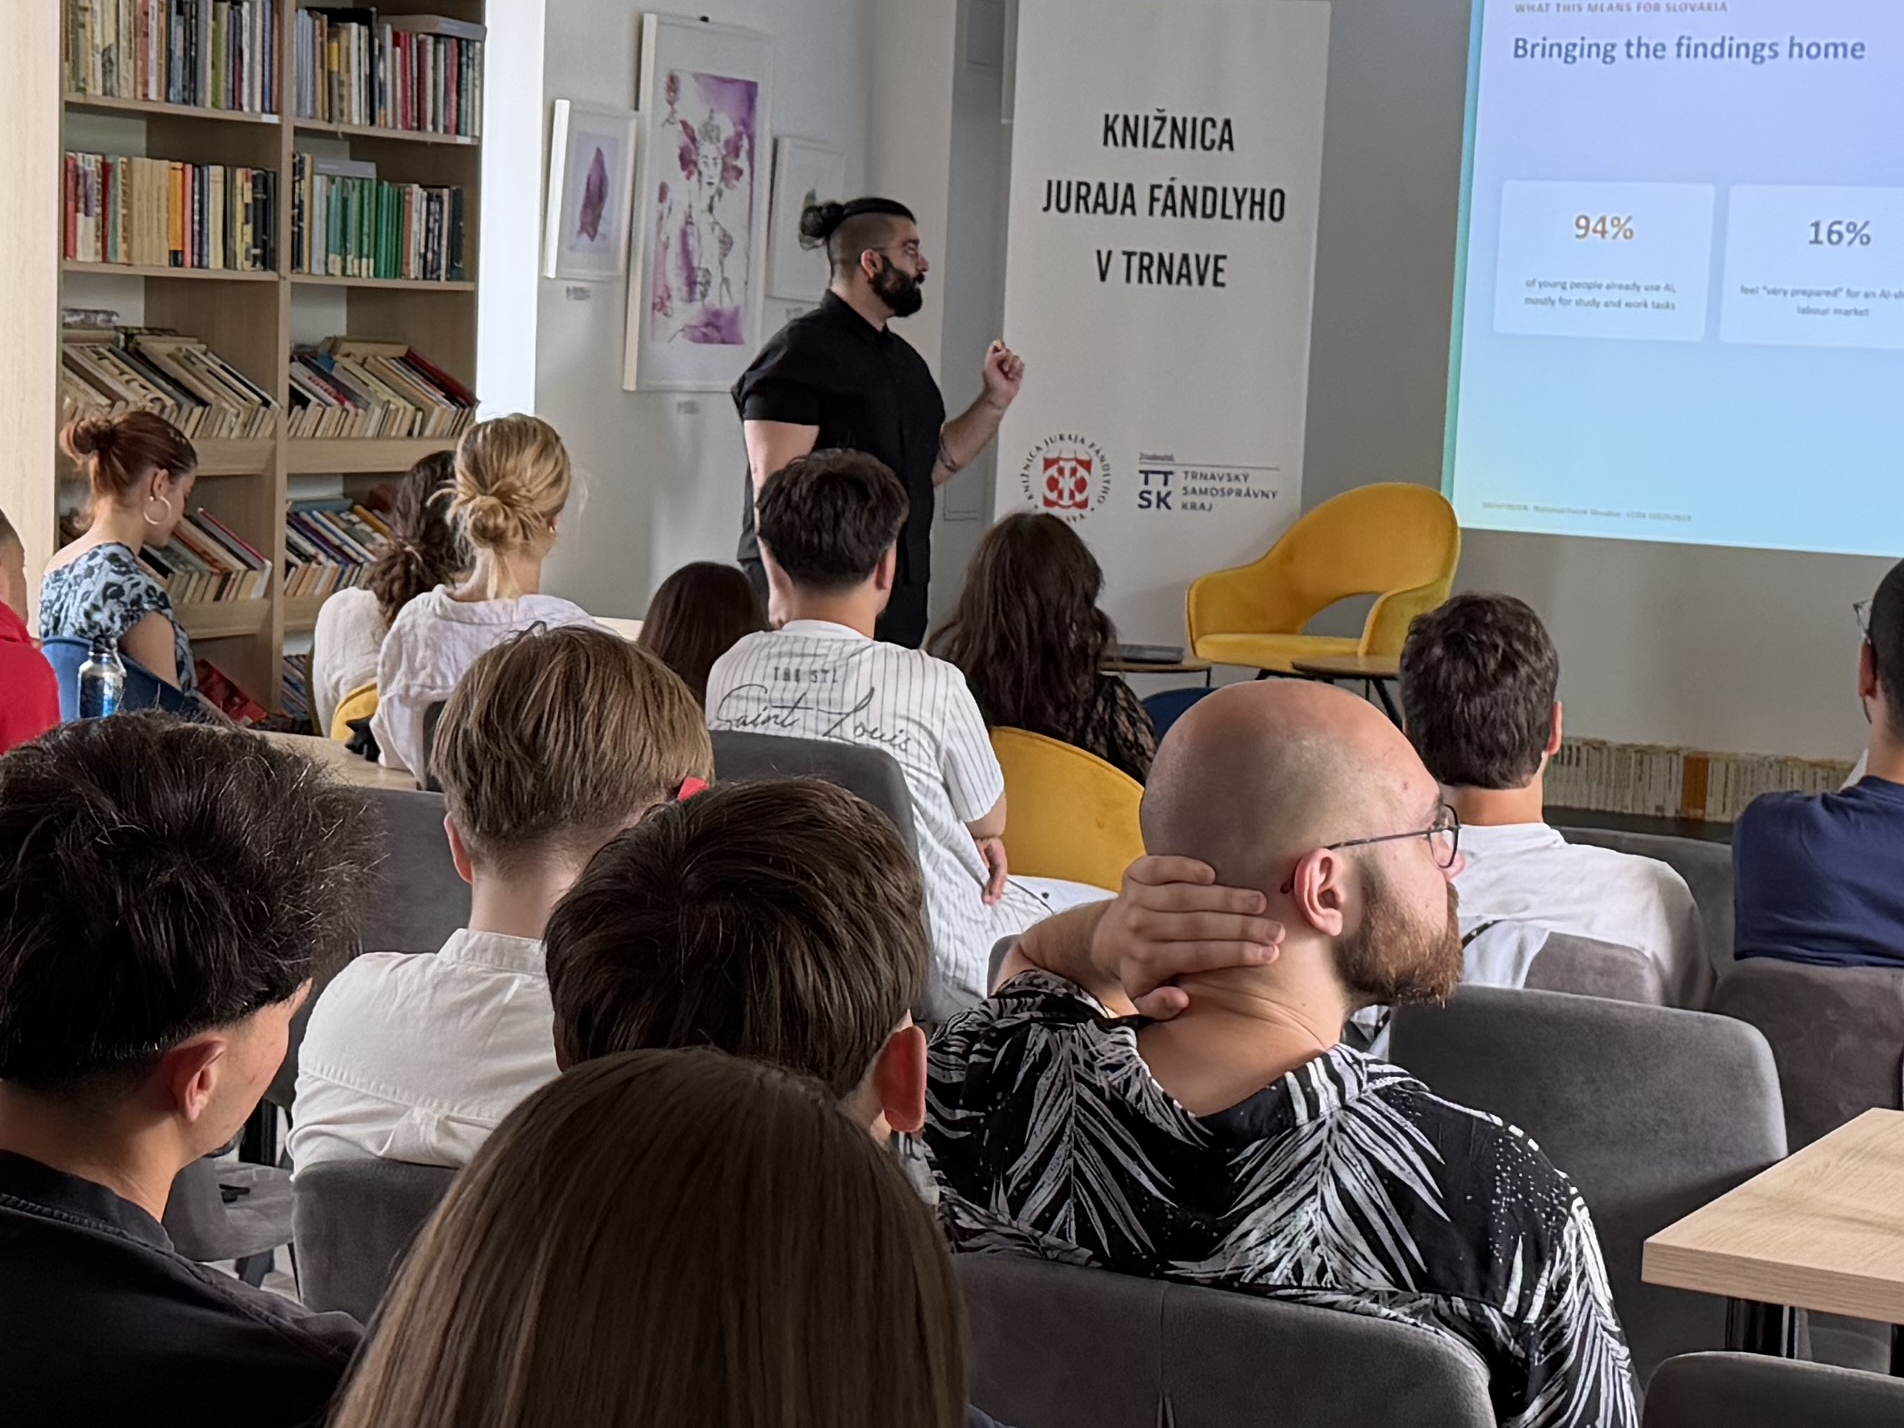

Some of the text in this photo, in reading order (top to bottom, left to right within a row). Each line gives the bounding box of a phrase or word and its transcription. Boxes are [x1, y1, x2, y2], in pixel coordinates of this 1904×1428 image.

[1515, 1, 1728, 13] WHAT THIS MEANS FOR SLOVAKIA
[1513, 35, 1866, 65] Bringing the findings home
[1102, 107, 1234, 152] KNIŽNICA
[1042, 176, 1286, 223] JURAJA FÁNDLYHO
[1574, 214, 1635, 241] 94%
[1808, 219, 1872, 247] 16%
[1096, 249, 1228, 288] V TRNAVE
[1137, 490, 1173, 510] SK
[1181, 501, 1213, 512] KRAJ
[717, 683, 911, 752] Saint Louis
